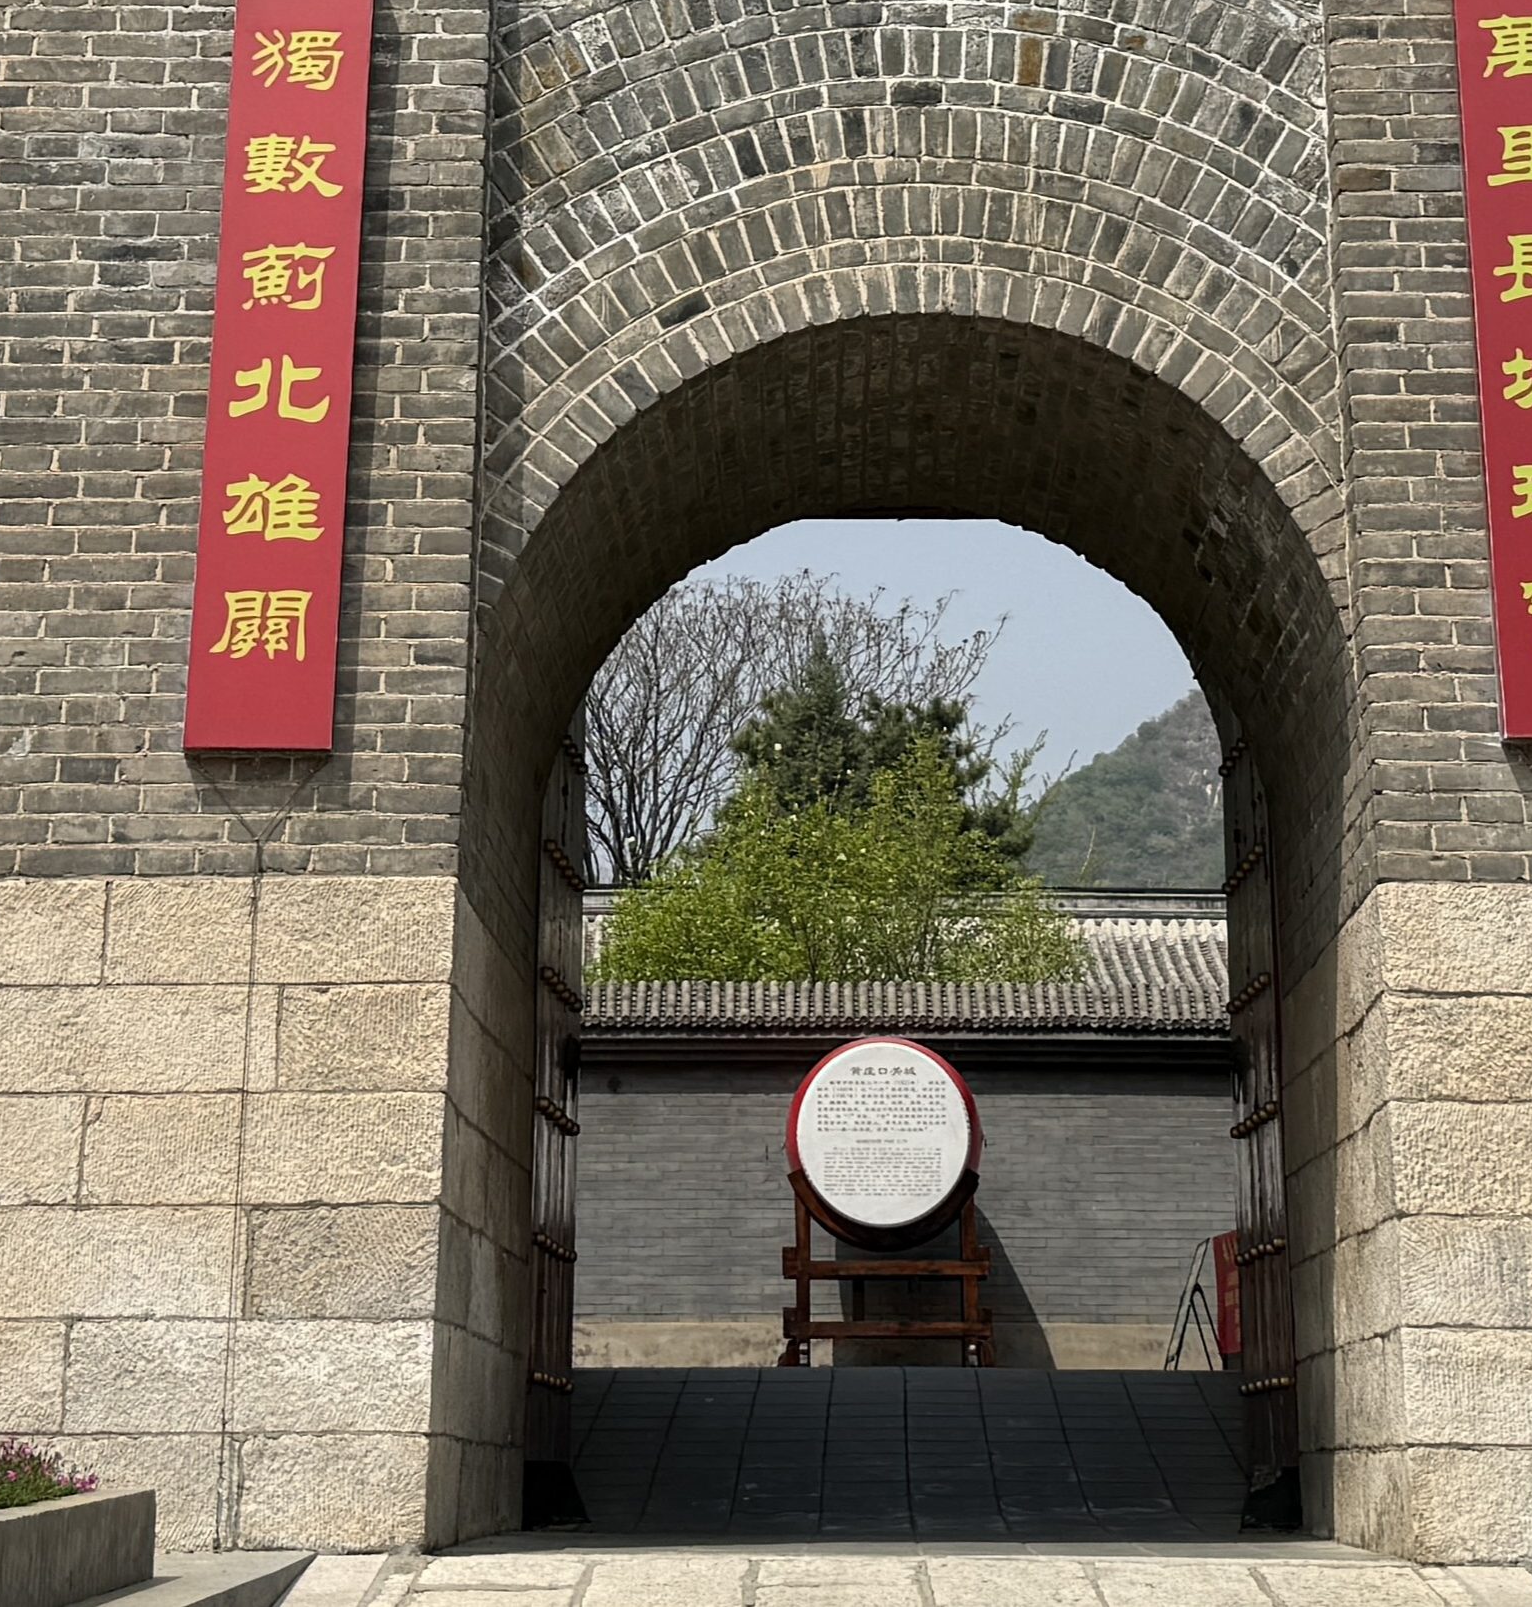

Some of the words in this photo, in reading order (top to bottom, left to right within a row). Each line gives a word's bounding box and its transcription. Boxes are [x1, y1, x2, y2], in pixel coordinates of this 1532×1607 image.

[209, 29, 344, 662] 獨數薊北雄關
